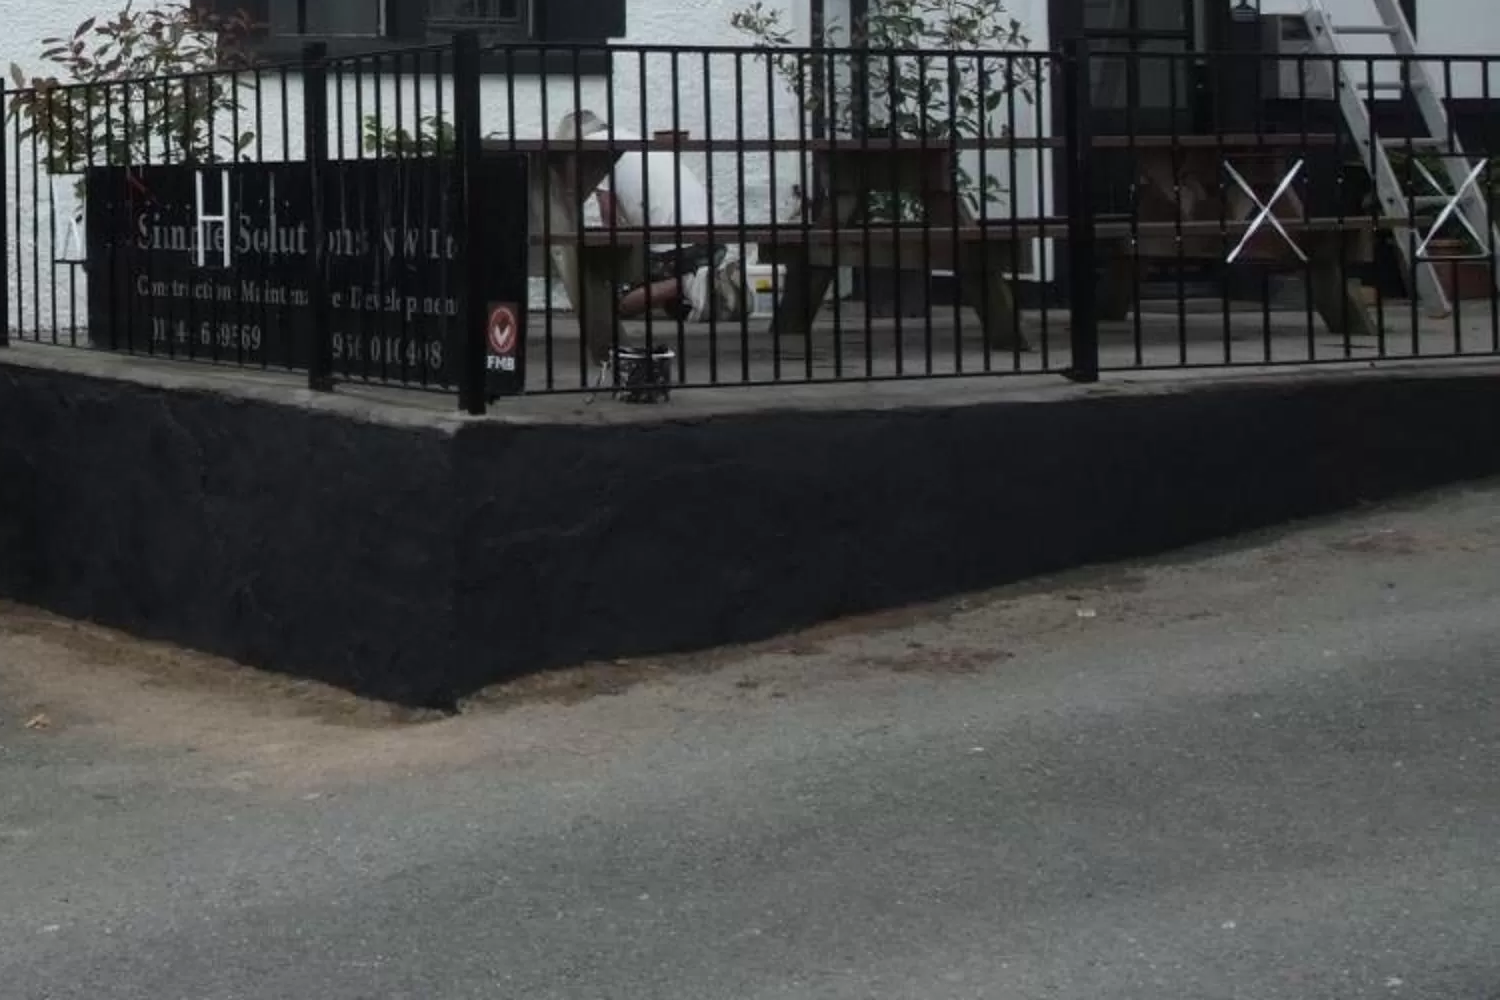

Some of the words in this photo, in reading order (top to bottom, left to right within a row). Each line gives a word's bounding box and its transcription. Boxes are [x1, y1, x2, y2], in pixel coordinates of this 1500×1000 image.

[235, 212, 370, 257] Solutons
[136, 273, 232, 301] Contrction
[240, 279, 341, 308] Mintnae
[349, 286, 459, 322] Developen
[486, 355, 516, 371] FMB
